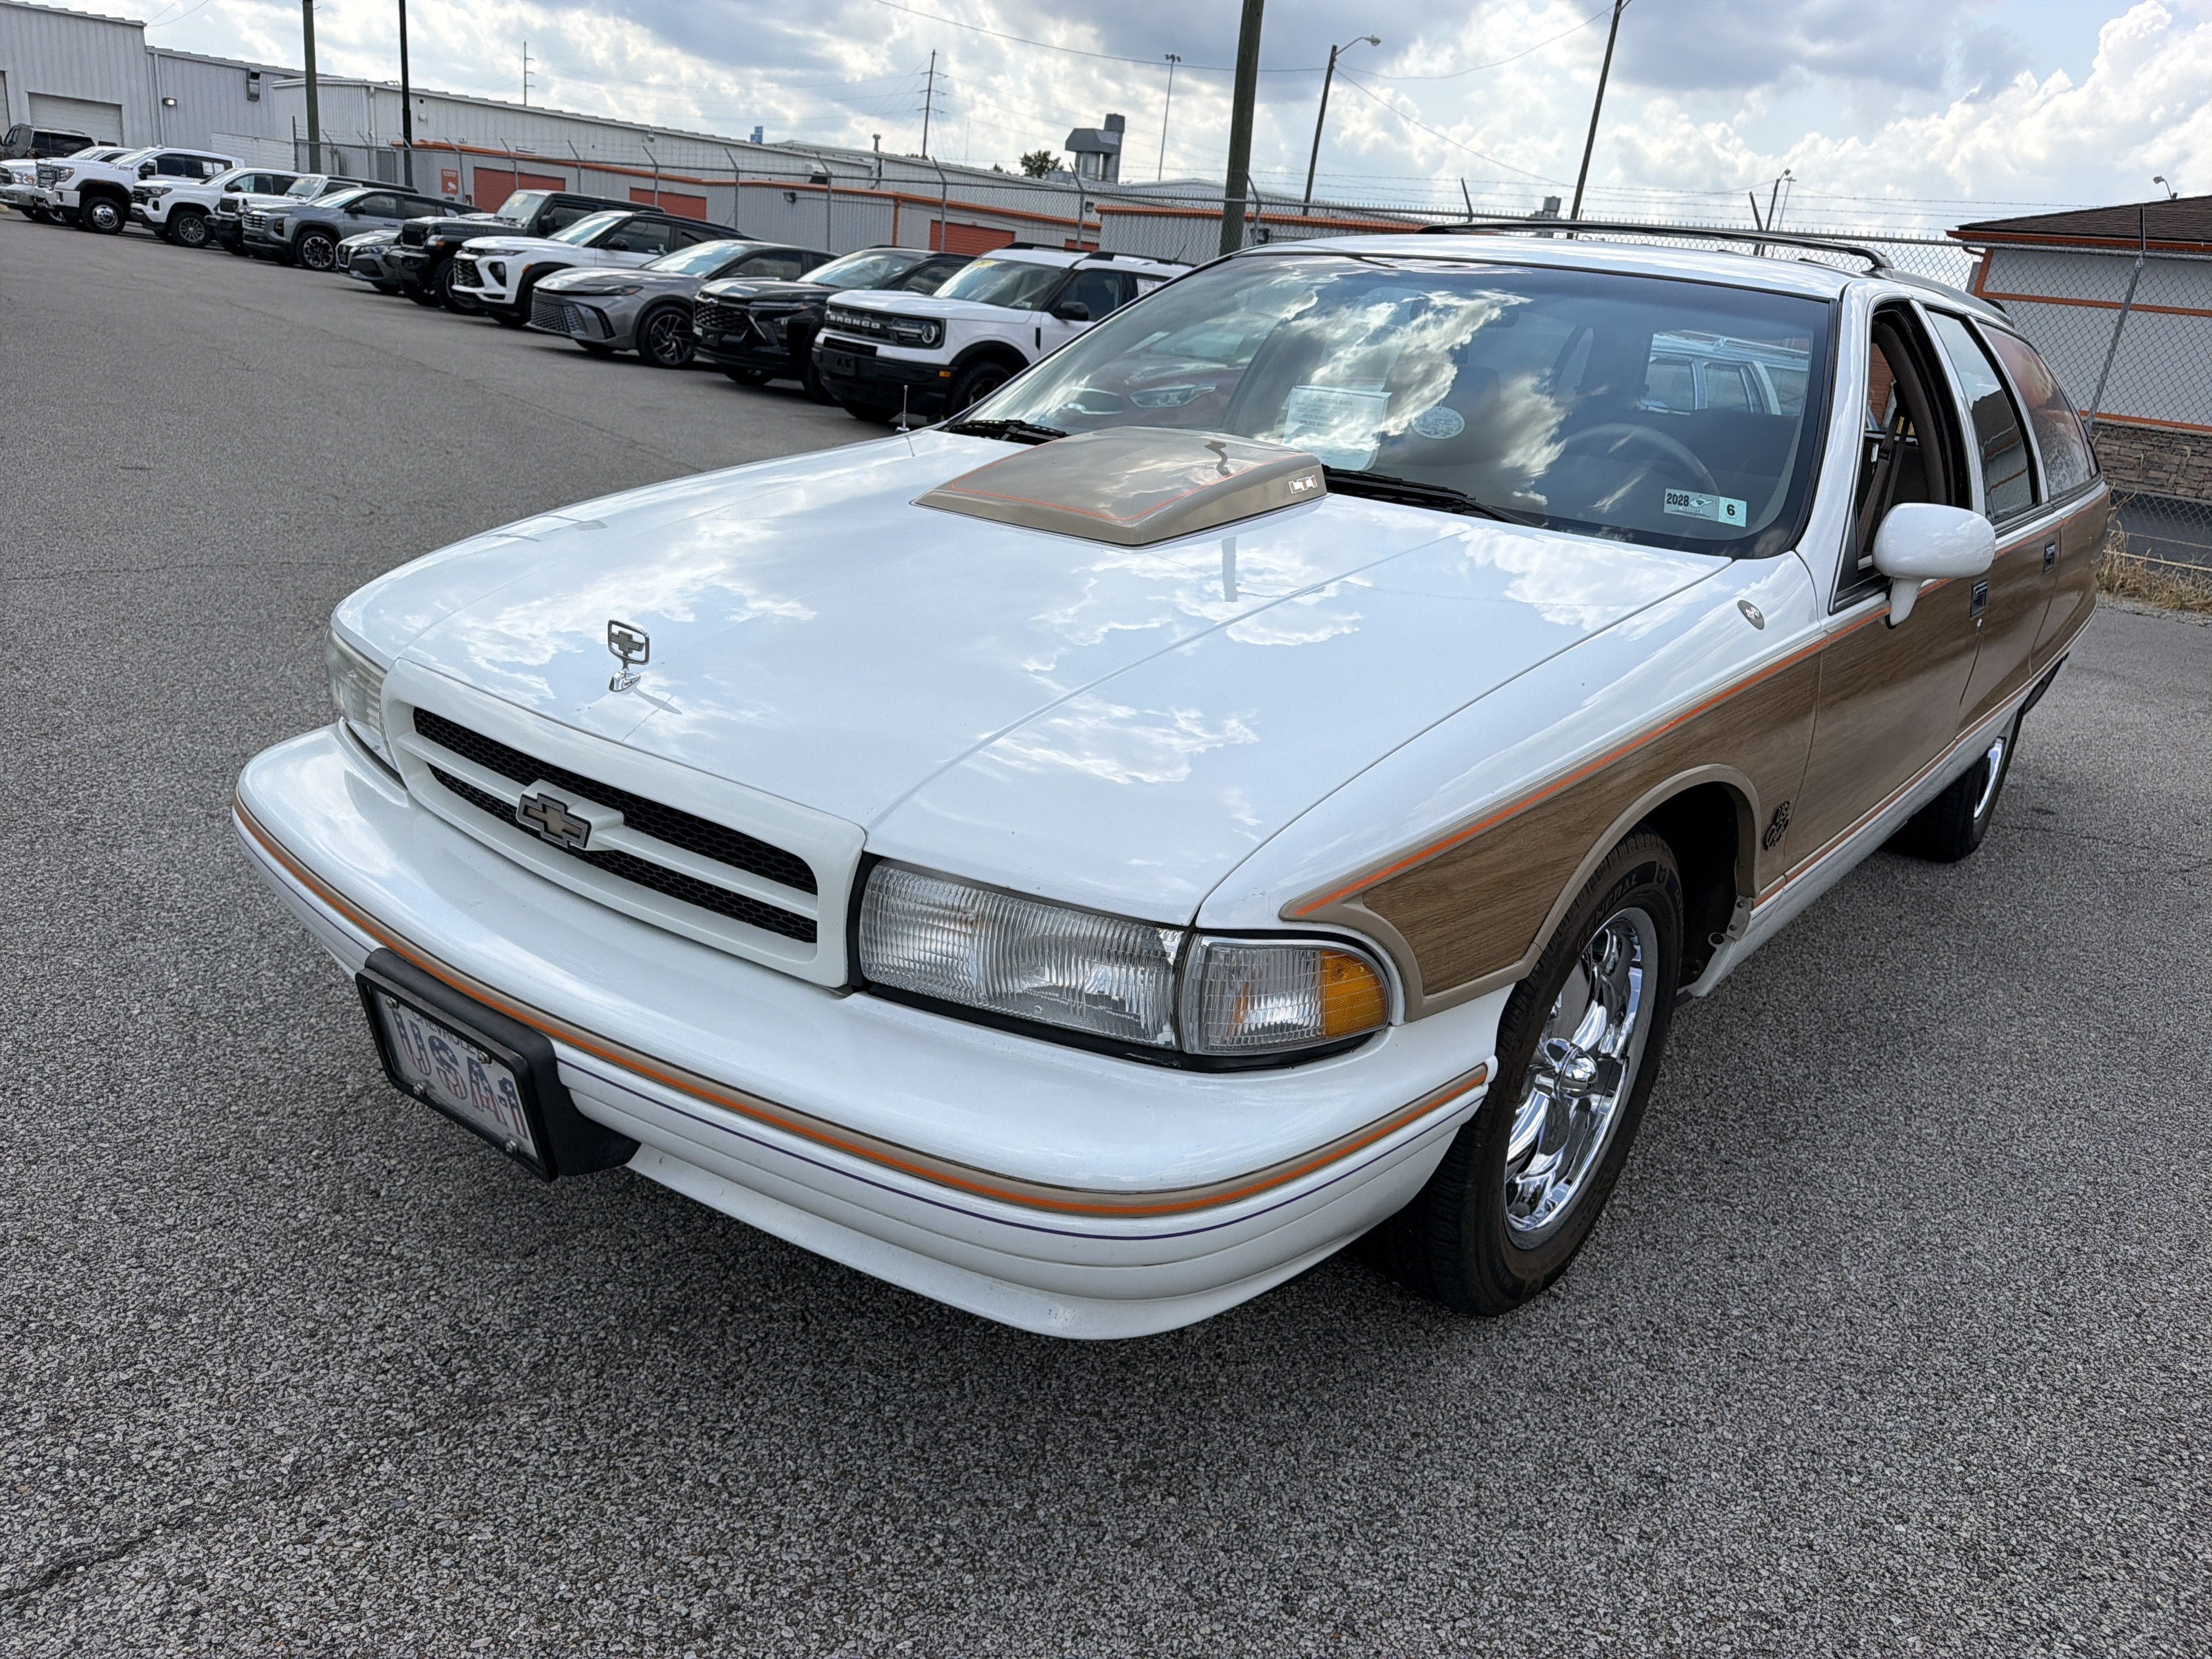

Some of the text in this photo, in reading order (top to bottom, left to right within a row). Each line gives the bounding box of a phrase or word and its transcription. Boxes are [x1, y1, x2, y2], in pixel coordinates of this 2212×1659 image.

[829, 314, 881, 329] BRONCO
[1288, 475, 1318, 494] LT1
[1666, 493, 1690, 507] 2028
[1726, 504, 1736, 516] 6
[411, 1011, 479, 1056] CHEVROLE
